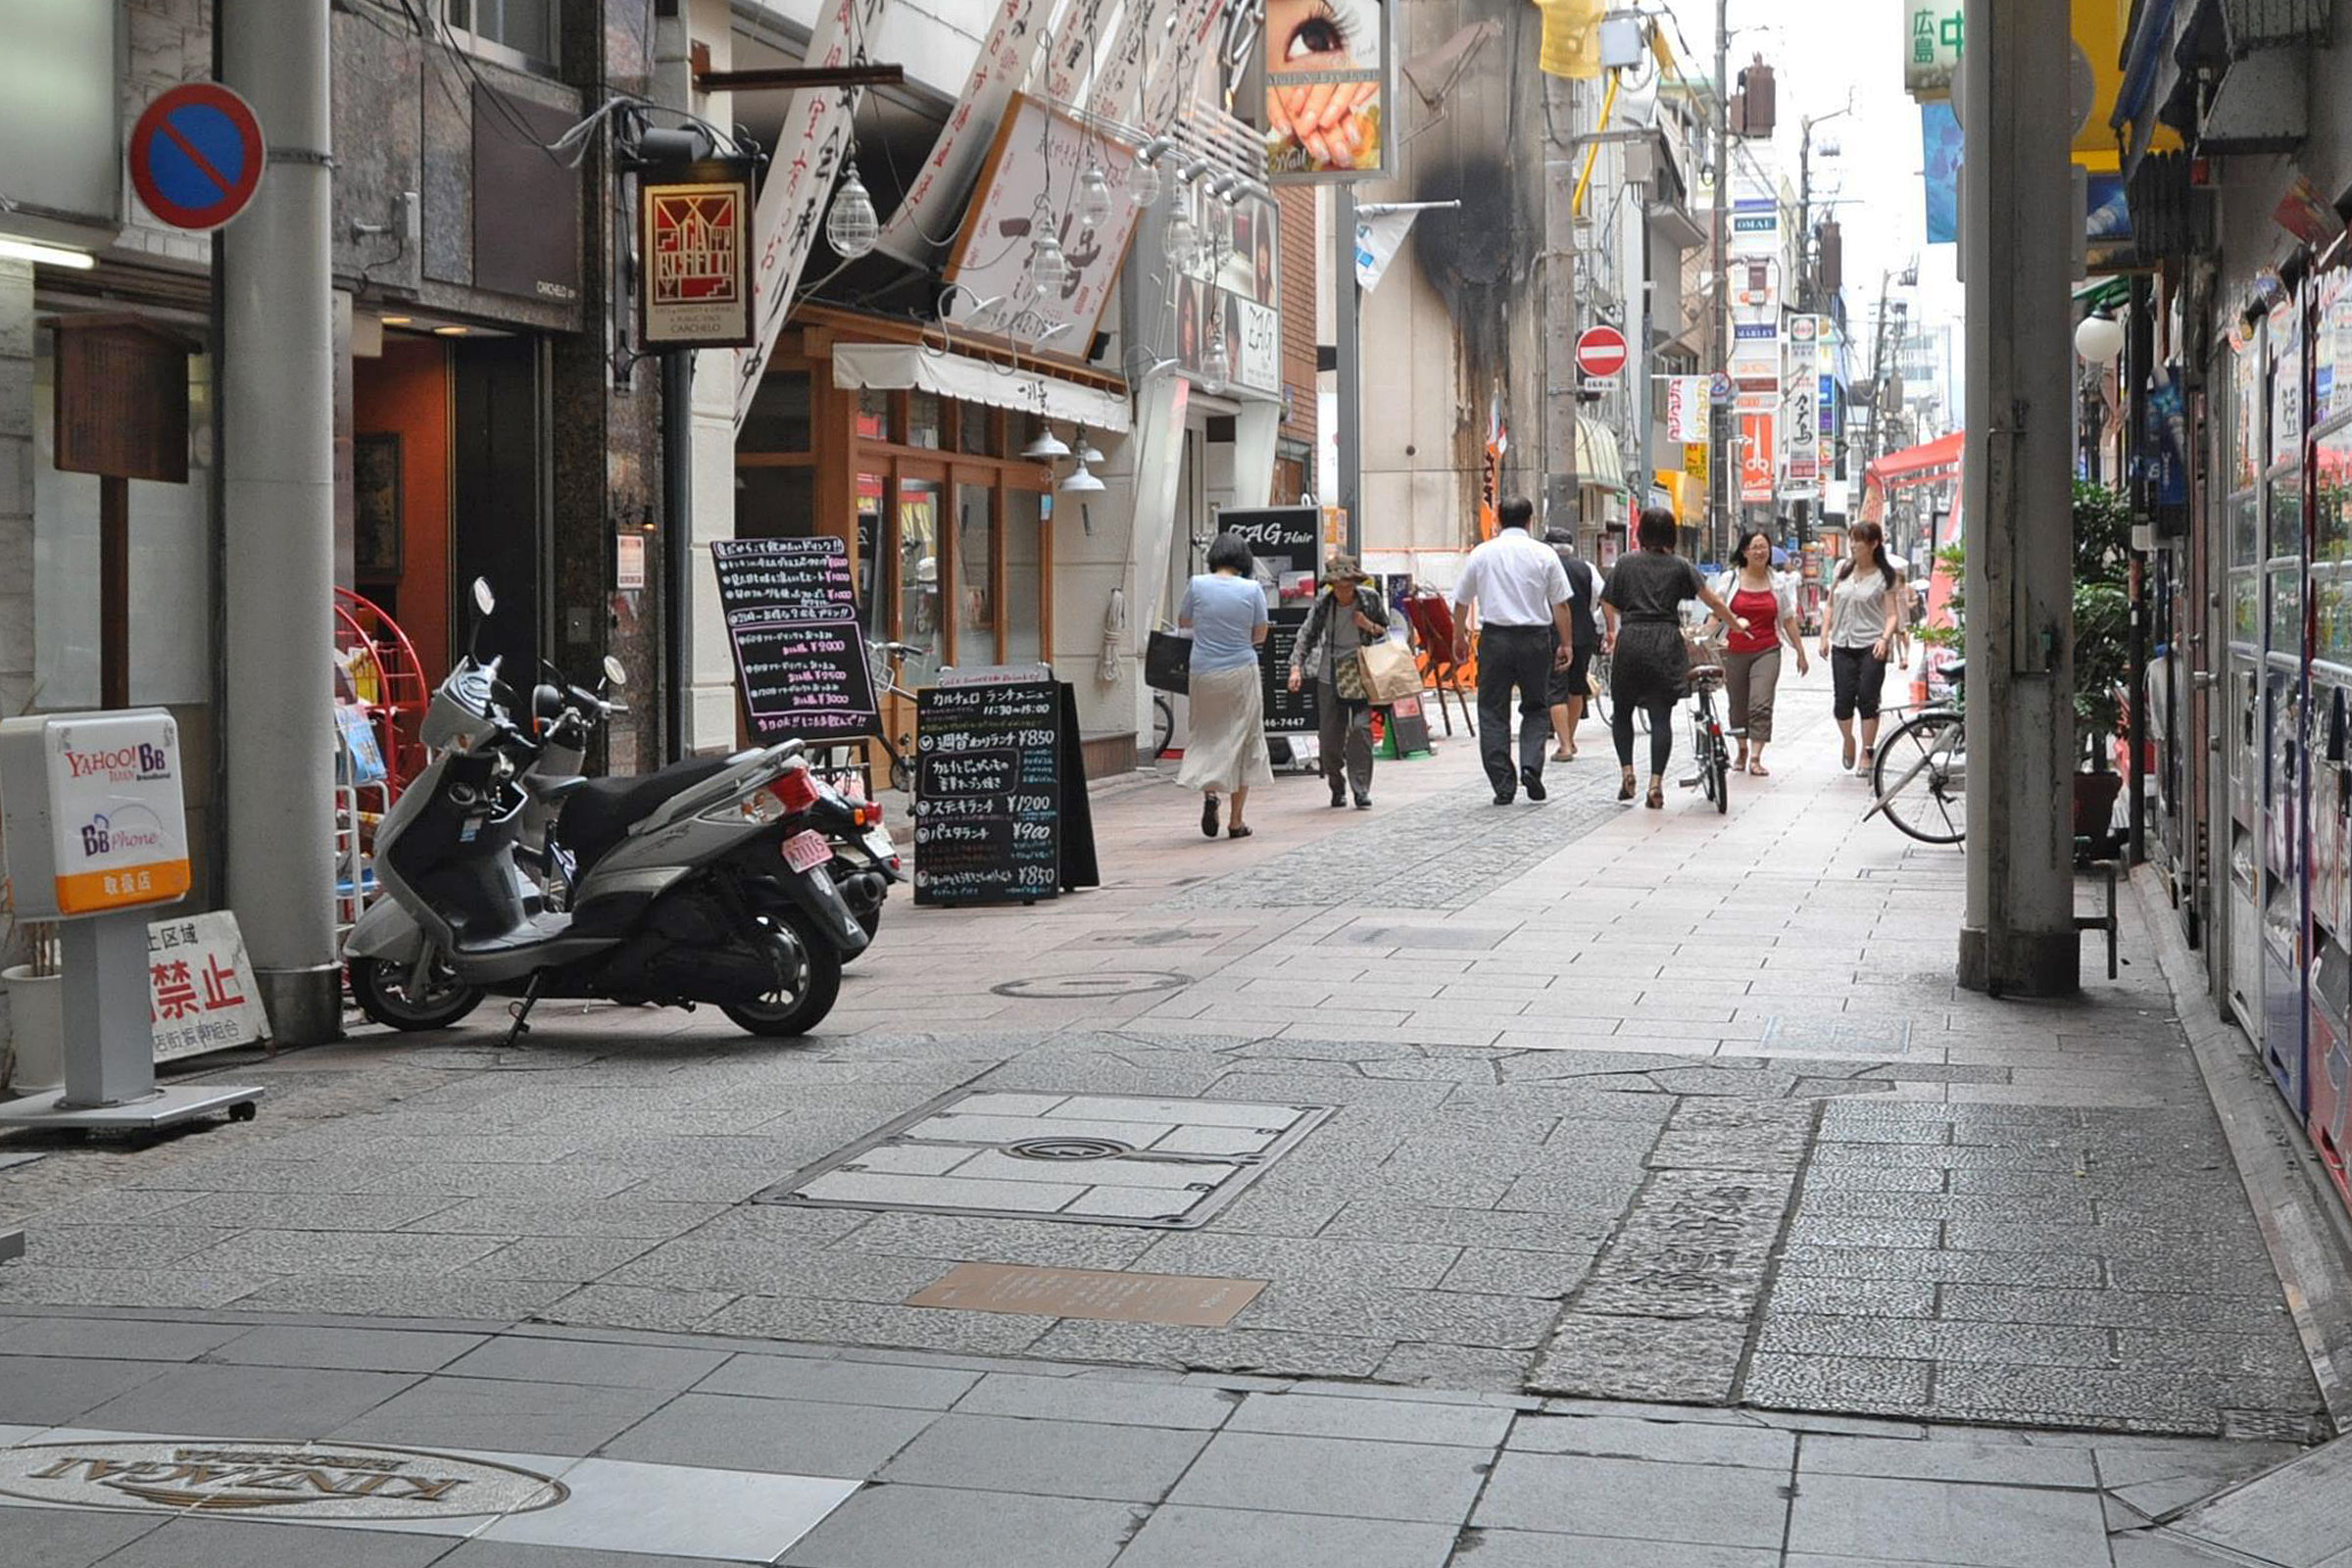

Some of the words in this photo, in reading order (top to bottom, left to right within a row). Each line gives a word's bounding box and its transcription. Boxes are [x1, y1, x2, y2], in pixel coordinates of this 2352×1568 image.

[1913, 8, 1935, 64] 広島
[1283, 530, 1313, 544] Hair
[809, 640, 845, 652] ¥2000
[818, 694, 849, 705] ¥3000
[933, 691, 980, 707] カルチェロ
[986, 688, 1054, 703] ランチメニュー
[1018, 729, 1054, 747] ¥850
[65, 746, 138, 778] YAHOO!
[1006, 795, 1051, 813] ¥1200
[111, 830, 159, 851] Phone
[931, 822, 990, 841] パスタランチ
[1012, 821, 1051, 840] ¥900
[103, 870, 152, 896] 取扱店
[1018, 865, 1055, 886] ¥850
[149, 953, 245, 1023] 禁止
[26, 1456, 470, 1502] KINZAGAI
